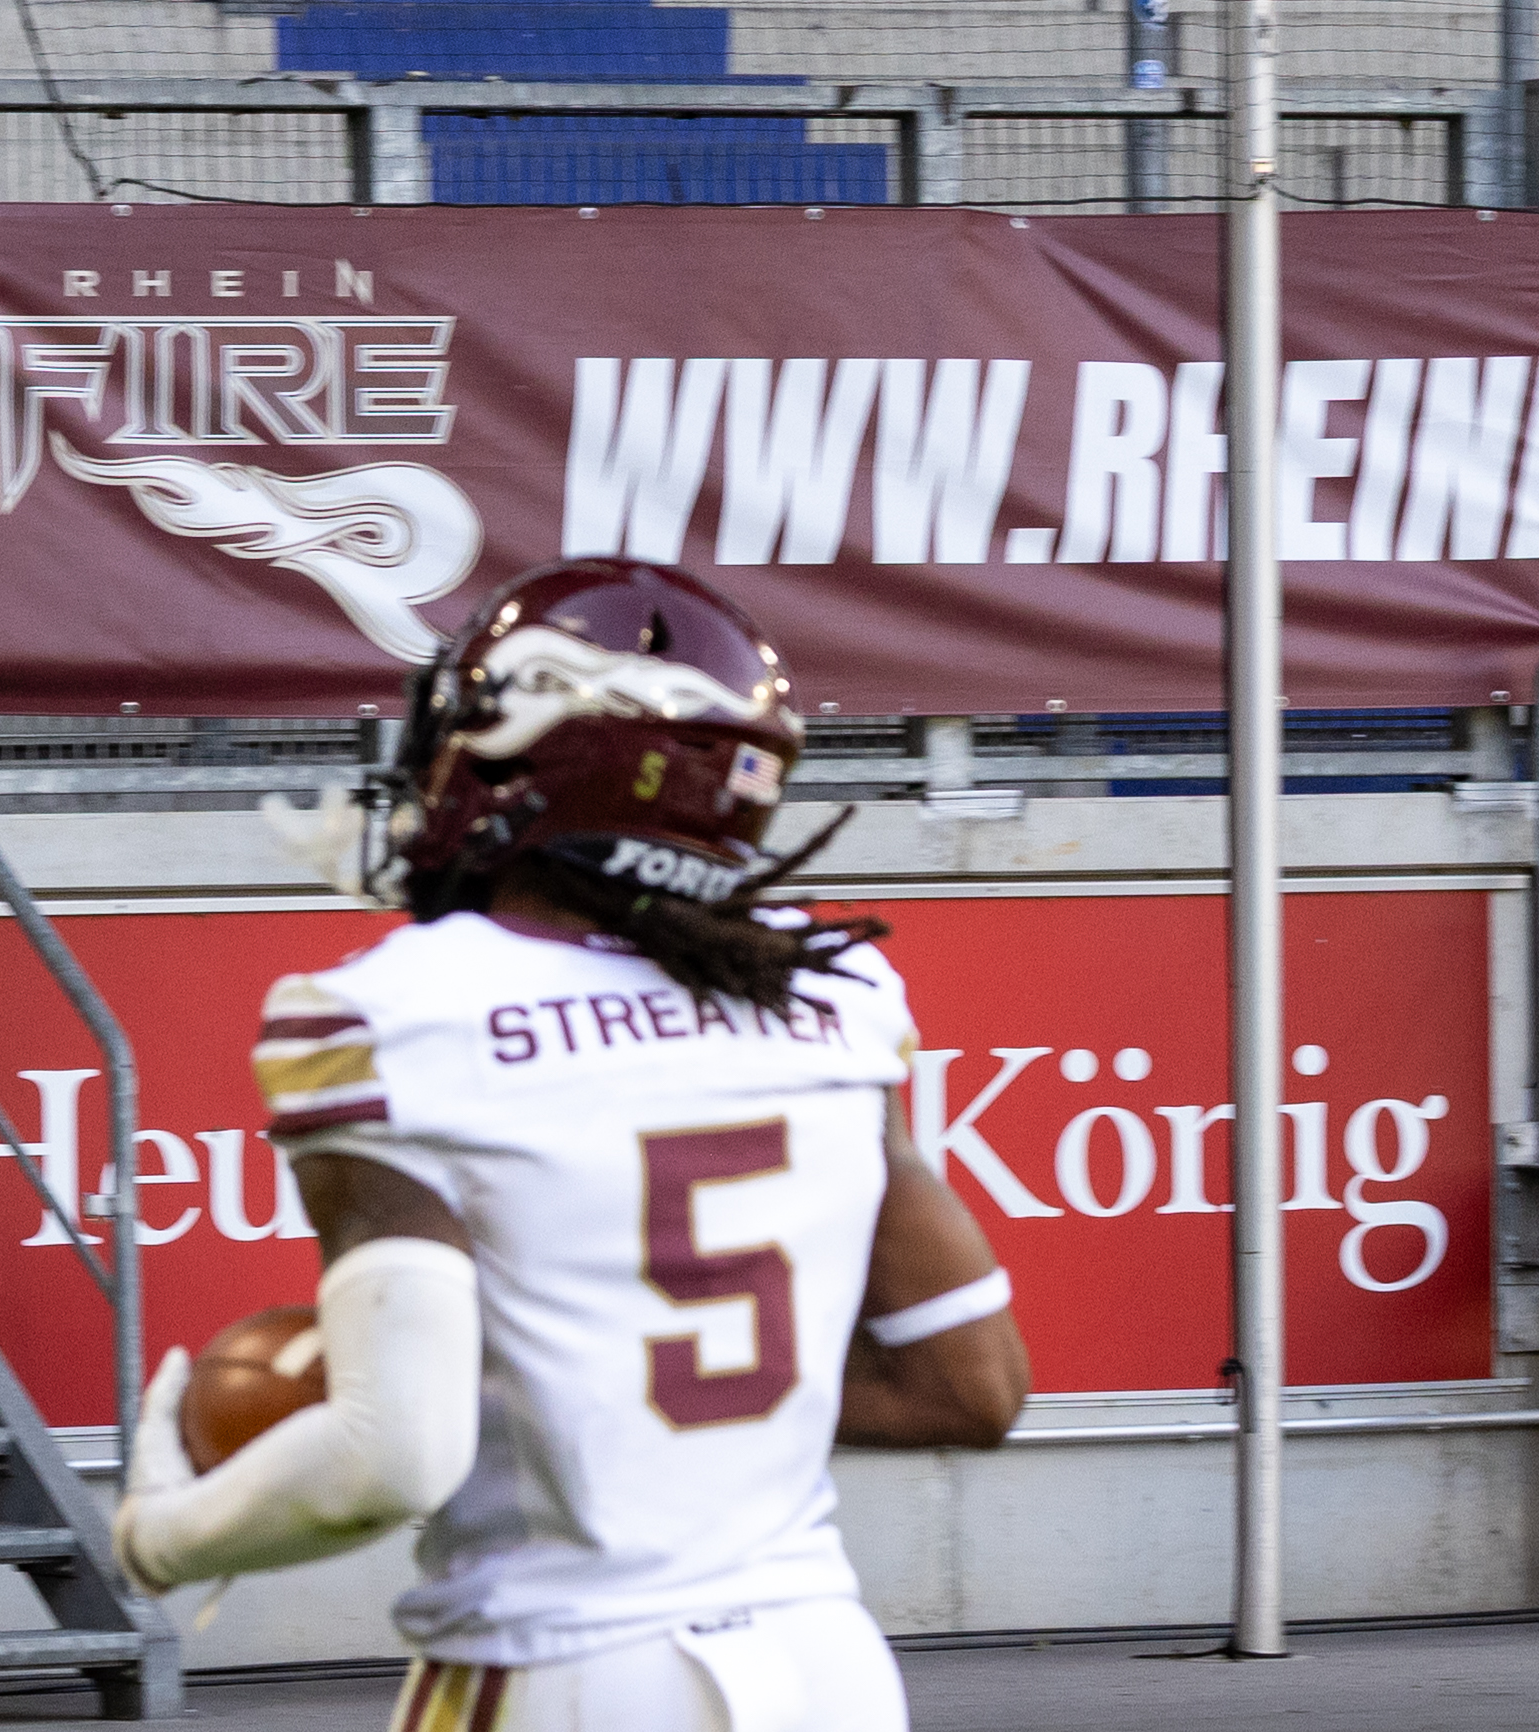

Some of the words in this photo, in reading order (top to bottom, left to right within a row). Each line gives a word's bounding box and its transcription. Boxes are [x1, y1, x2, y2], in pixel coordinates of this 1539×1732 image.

[63, 259, 373, 303] RHEIN
[638, 1114, 801, 1434] 5
[907, 1043, 1450, 1293] König
